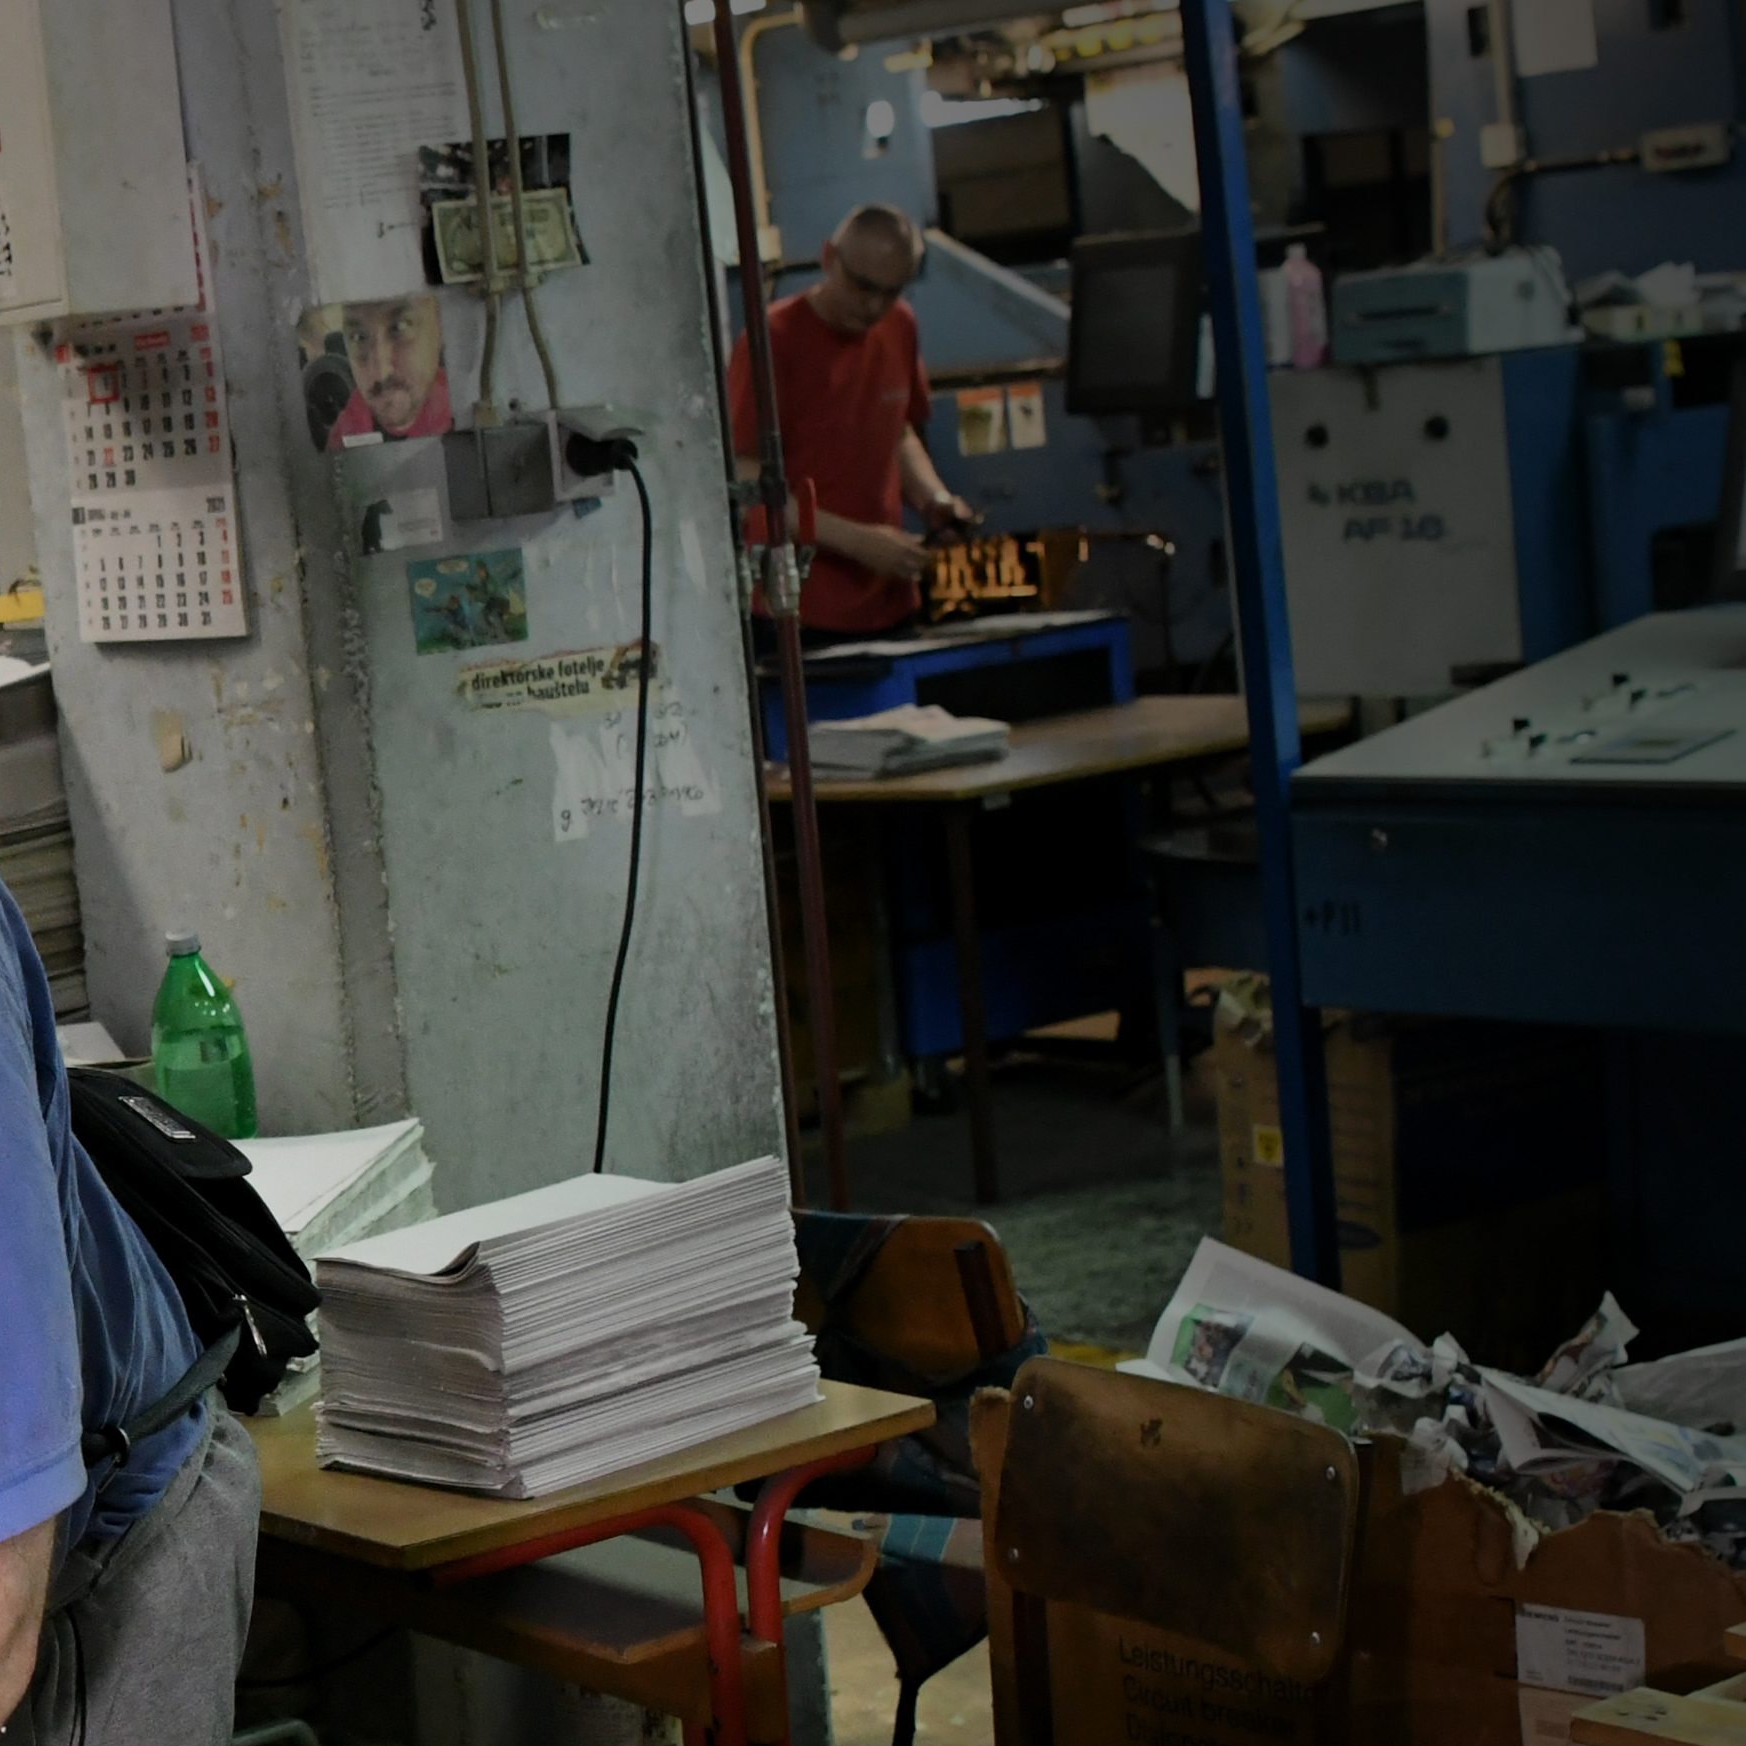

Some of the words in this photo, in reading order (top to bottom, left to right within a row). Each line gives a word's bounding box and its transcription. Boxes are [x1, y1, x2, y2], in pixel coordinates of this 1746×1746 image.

[471, 664, 554, 691] direktorske
[558, 656, 604, 677] fotelje
[1120, 1635, 1315, 1700] Leistungsschalte
[1200, 1699, 1295, 1737] breaker
